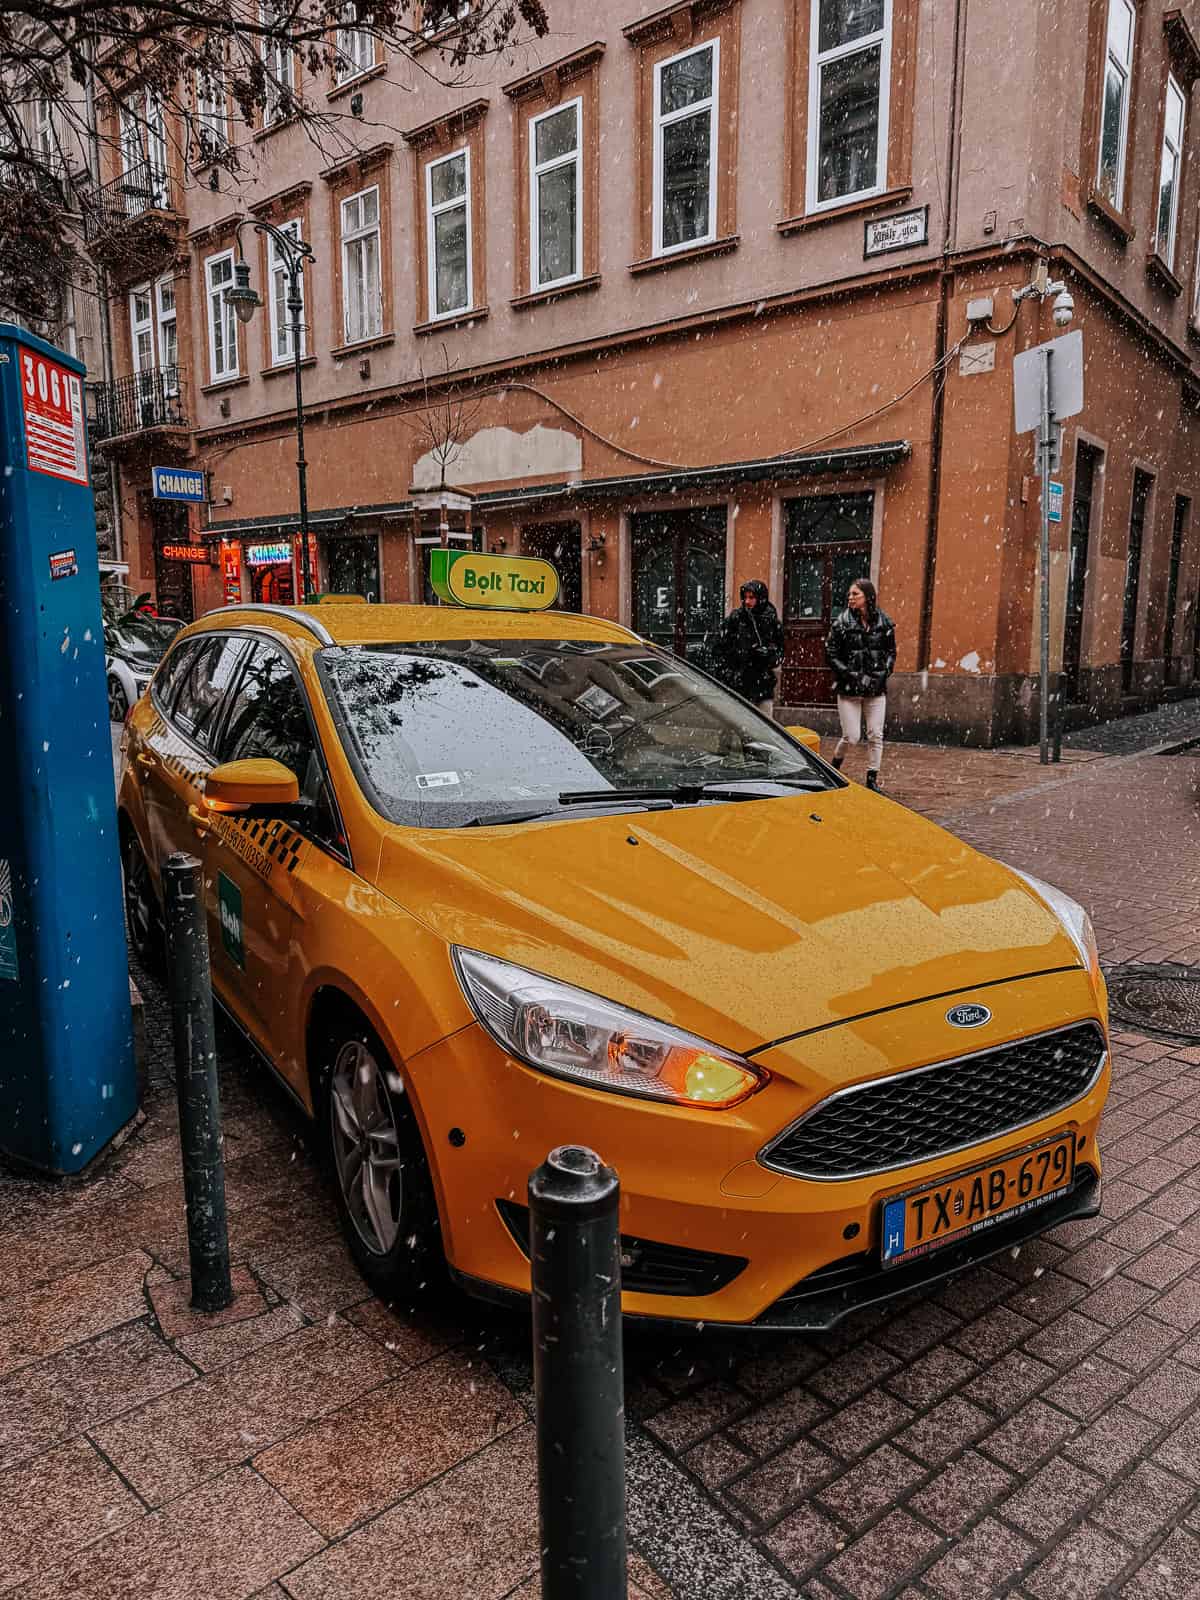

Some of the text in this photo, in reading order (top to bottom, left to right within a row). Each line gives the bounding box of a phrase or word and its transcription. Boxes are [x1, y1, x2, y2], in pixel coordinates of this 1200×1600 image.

[23, 355, 71, 412] 3061
[158, 474, 202, 495] CHANGE
[162, 545, 209, 561] CHANGE
[463, 568, 546, 596] Bolt Taxi
[220, 899, 241, 943] Bolt
[956, 1006, 982, 1024] Ford
[911, 1187, 952, 1240] TX
[968, 1144, 1068, 1221] AB-679
[889, 1231, 900, 1249] H
